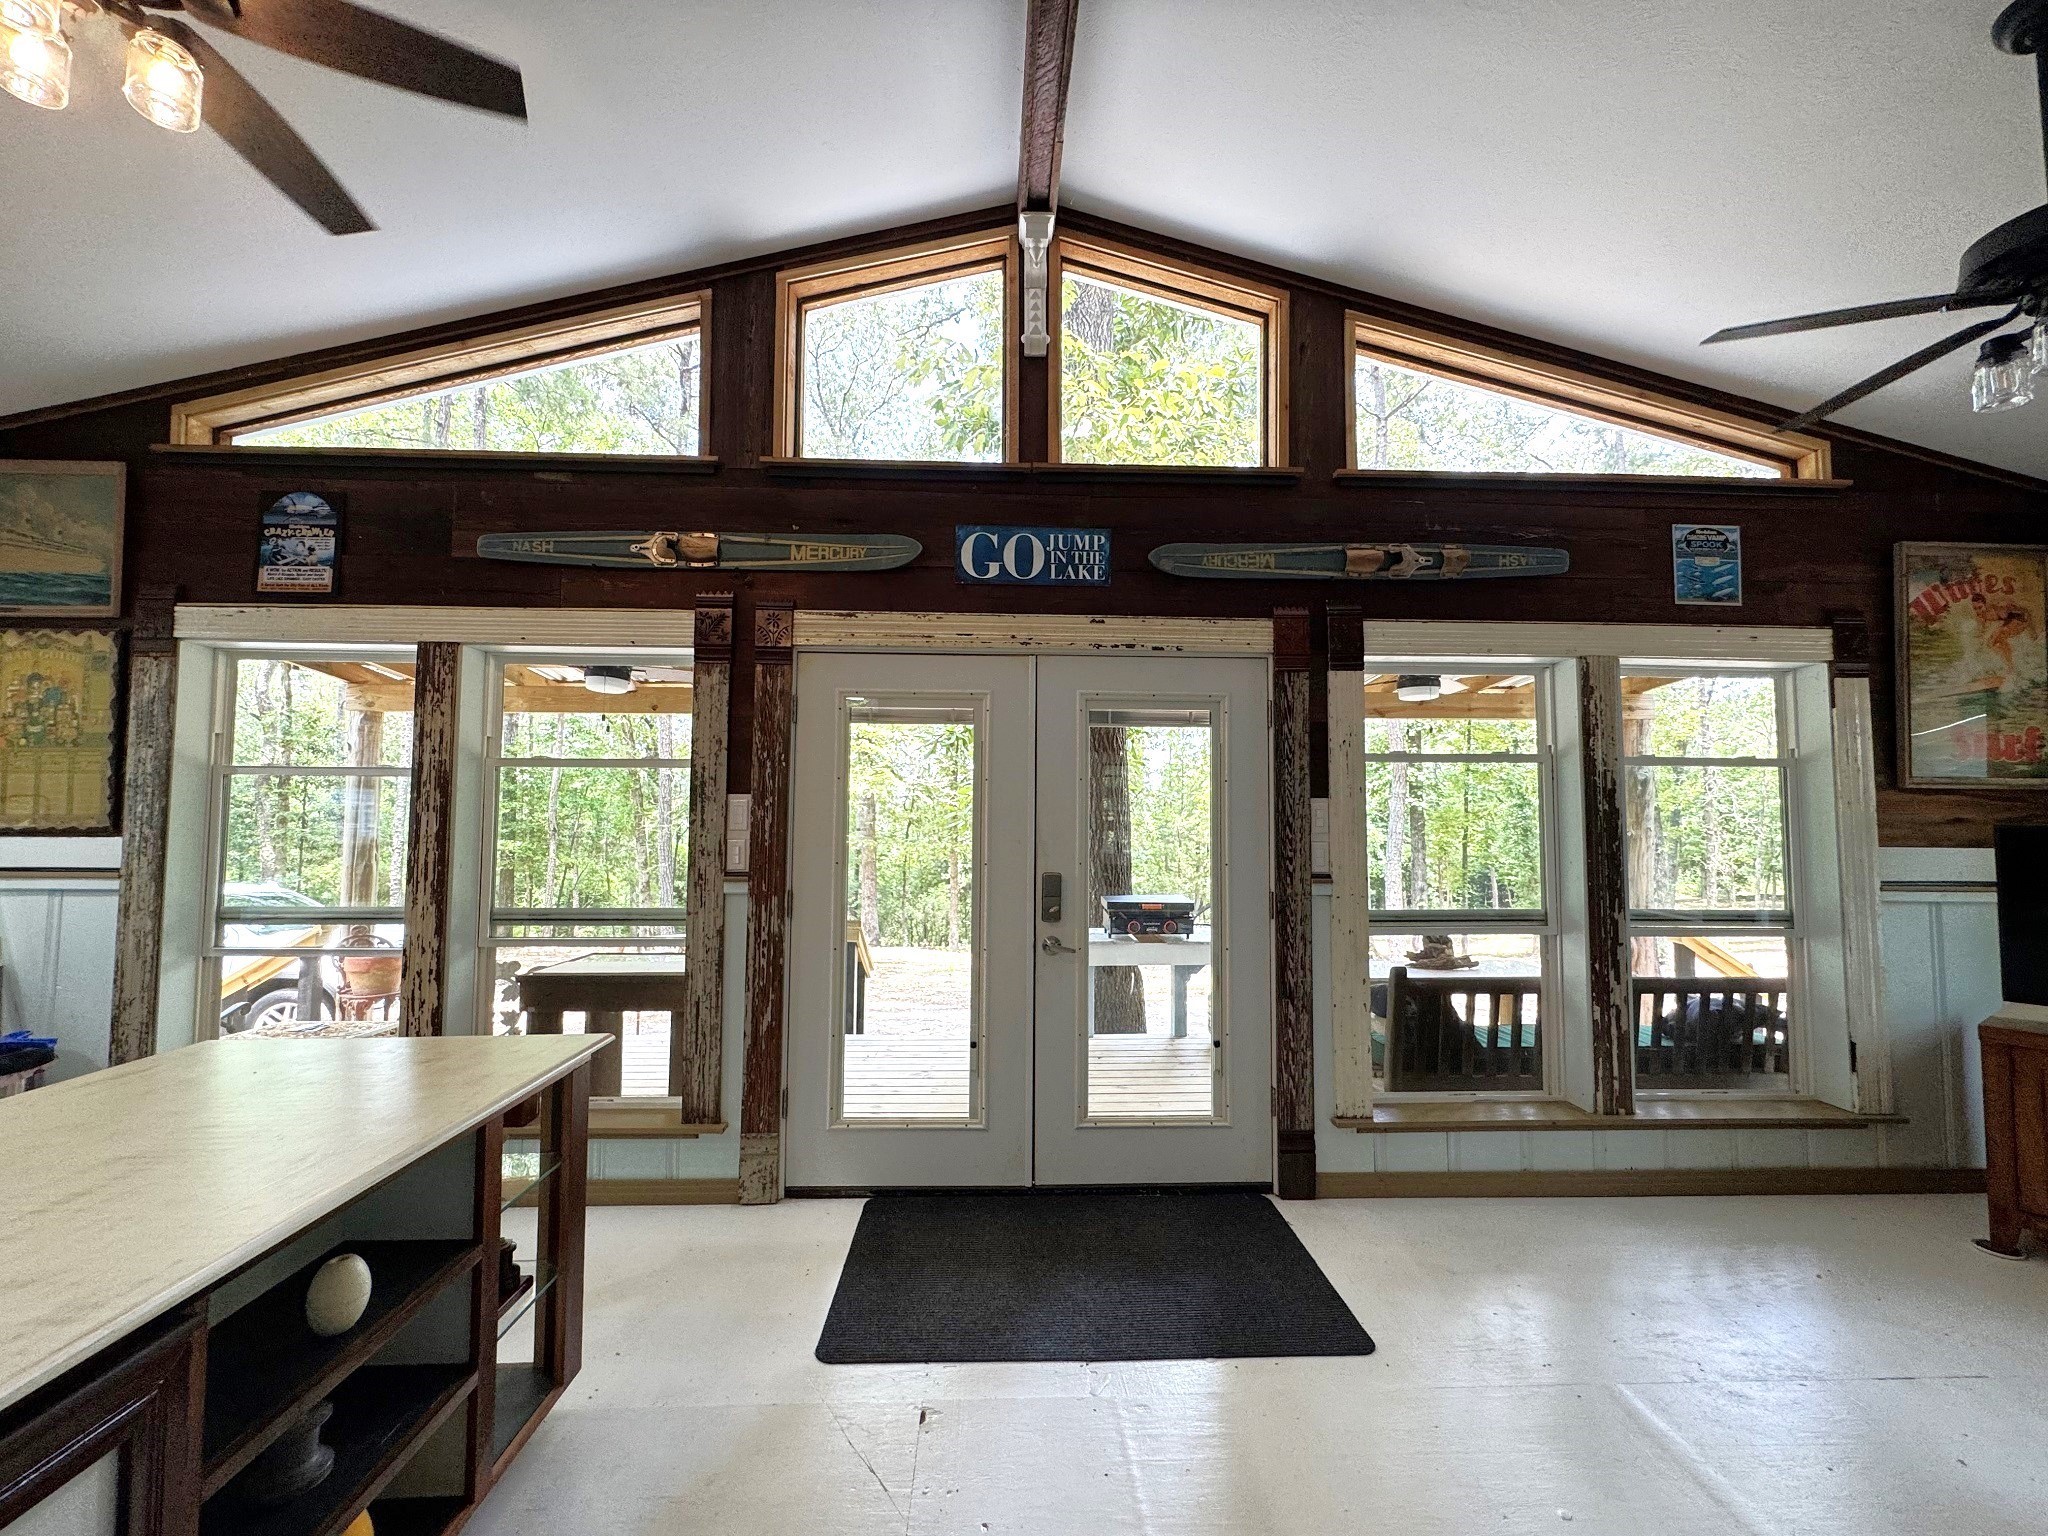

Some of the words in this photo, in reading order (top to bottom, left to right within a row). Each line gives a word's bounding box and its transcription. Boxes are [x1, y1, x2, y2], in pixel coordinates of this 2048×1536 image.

[512, 540, 554, 553] NASH
[1046, 533, 1106, 551] JUMP
[789, 544, 868, 561] MERCURY
[960, 531, 1045, 580] GO
[1050, 551, 1068, 565] IN
[1071, 551, 1106, 565] THE
[1201, 553, 1275, 569] MERCURY
[1049, 564, 1106, 581] LAKE
